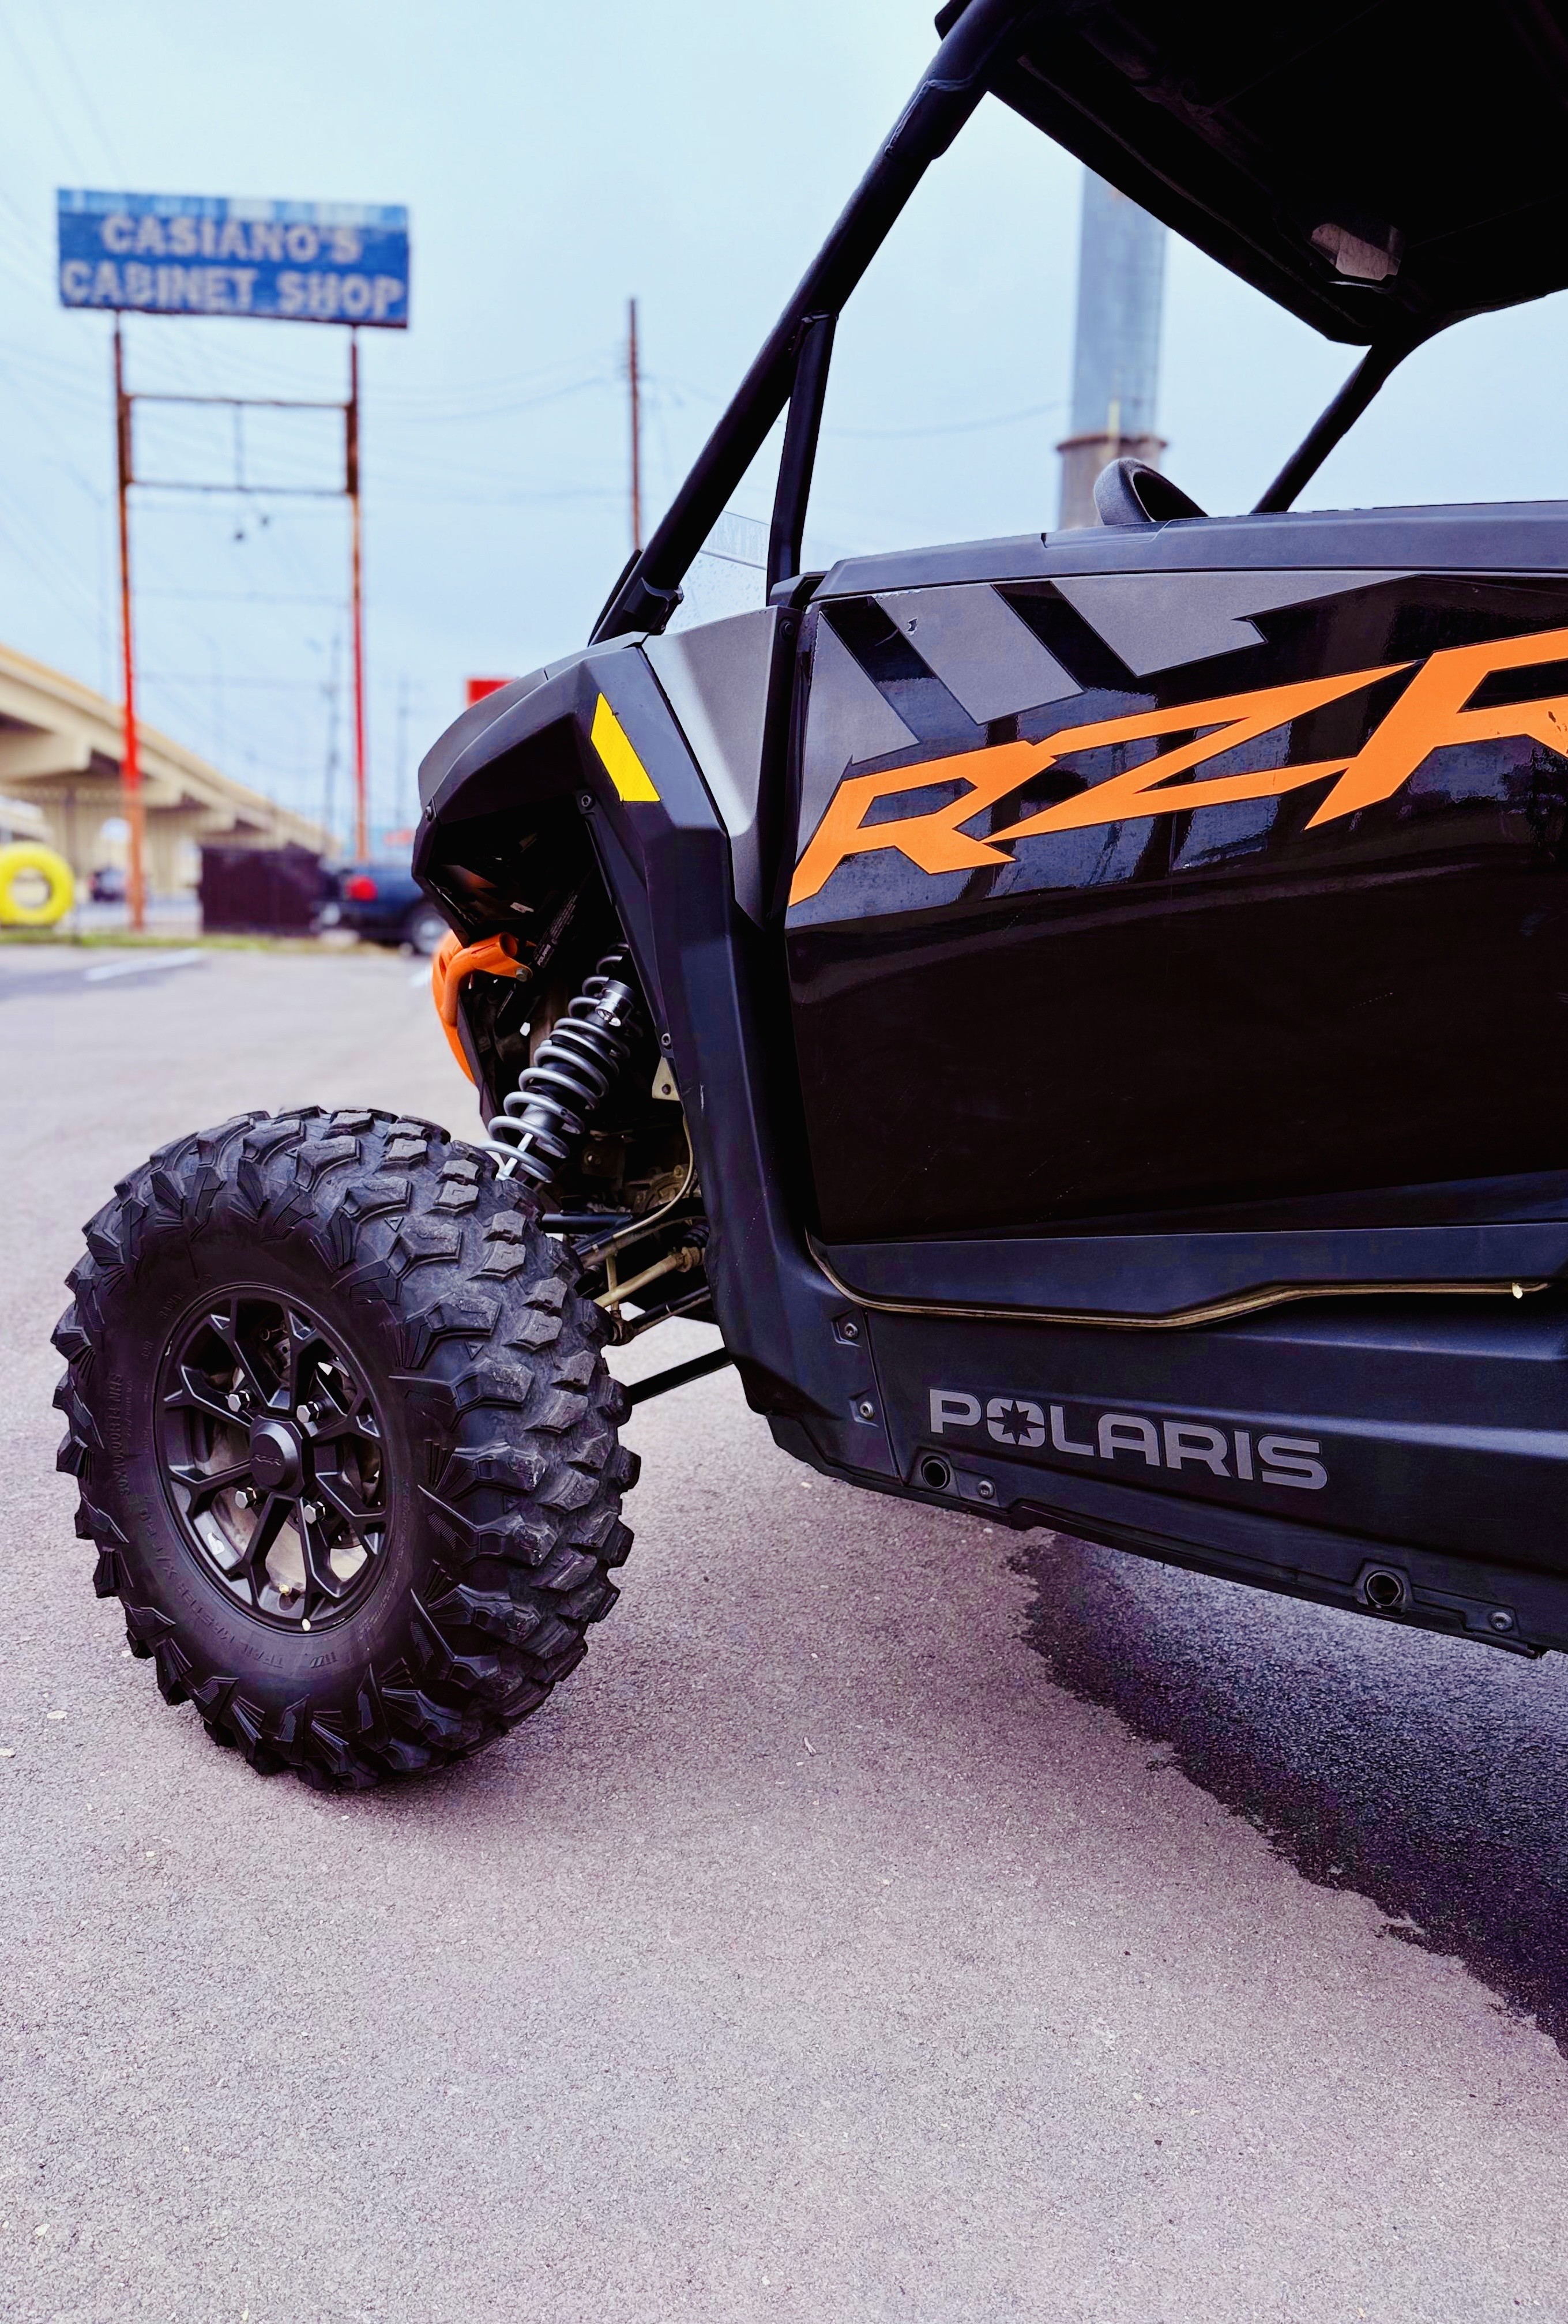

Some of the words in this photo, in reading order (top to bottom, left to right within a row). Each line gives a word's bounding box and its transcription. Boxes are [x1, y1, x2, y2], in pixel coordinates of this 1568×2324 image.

[101, 215, 363, 263] CASIANO'S
[62, 261, 258, 309] CABINET
[276, 271, 404, 317] SHOP
[929, 1388, 1329, 1491] POLARIS
